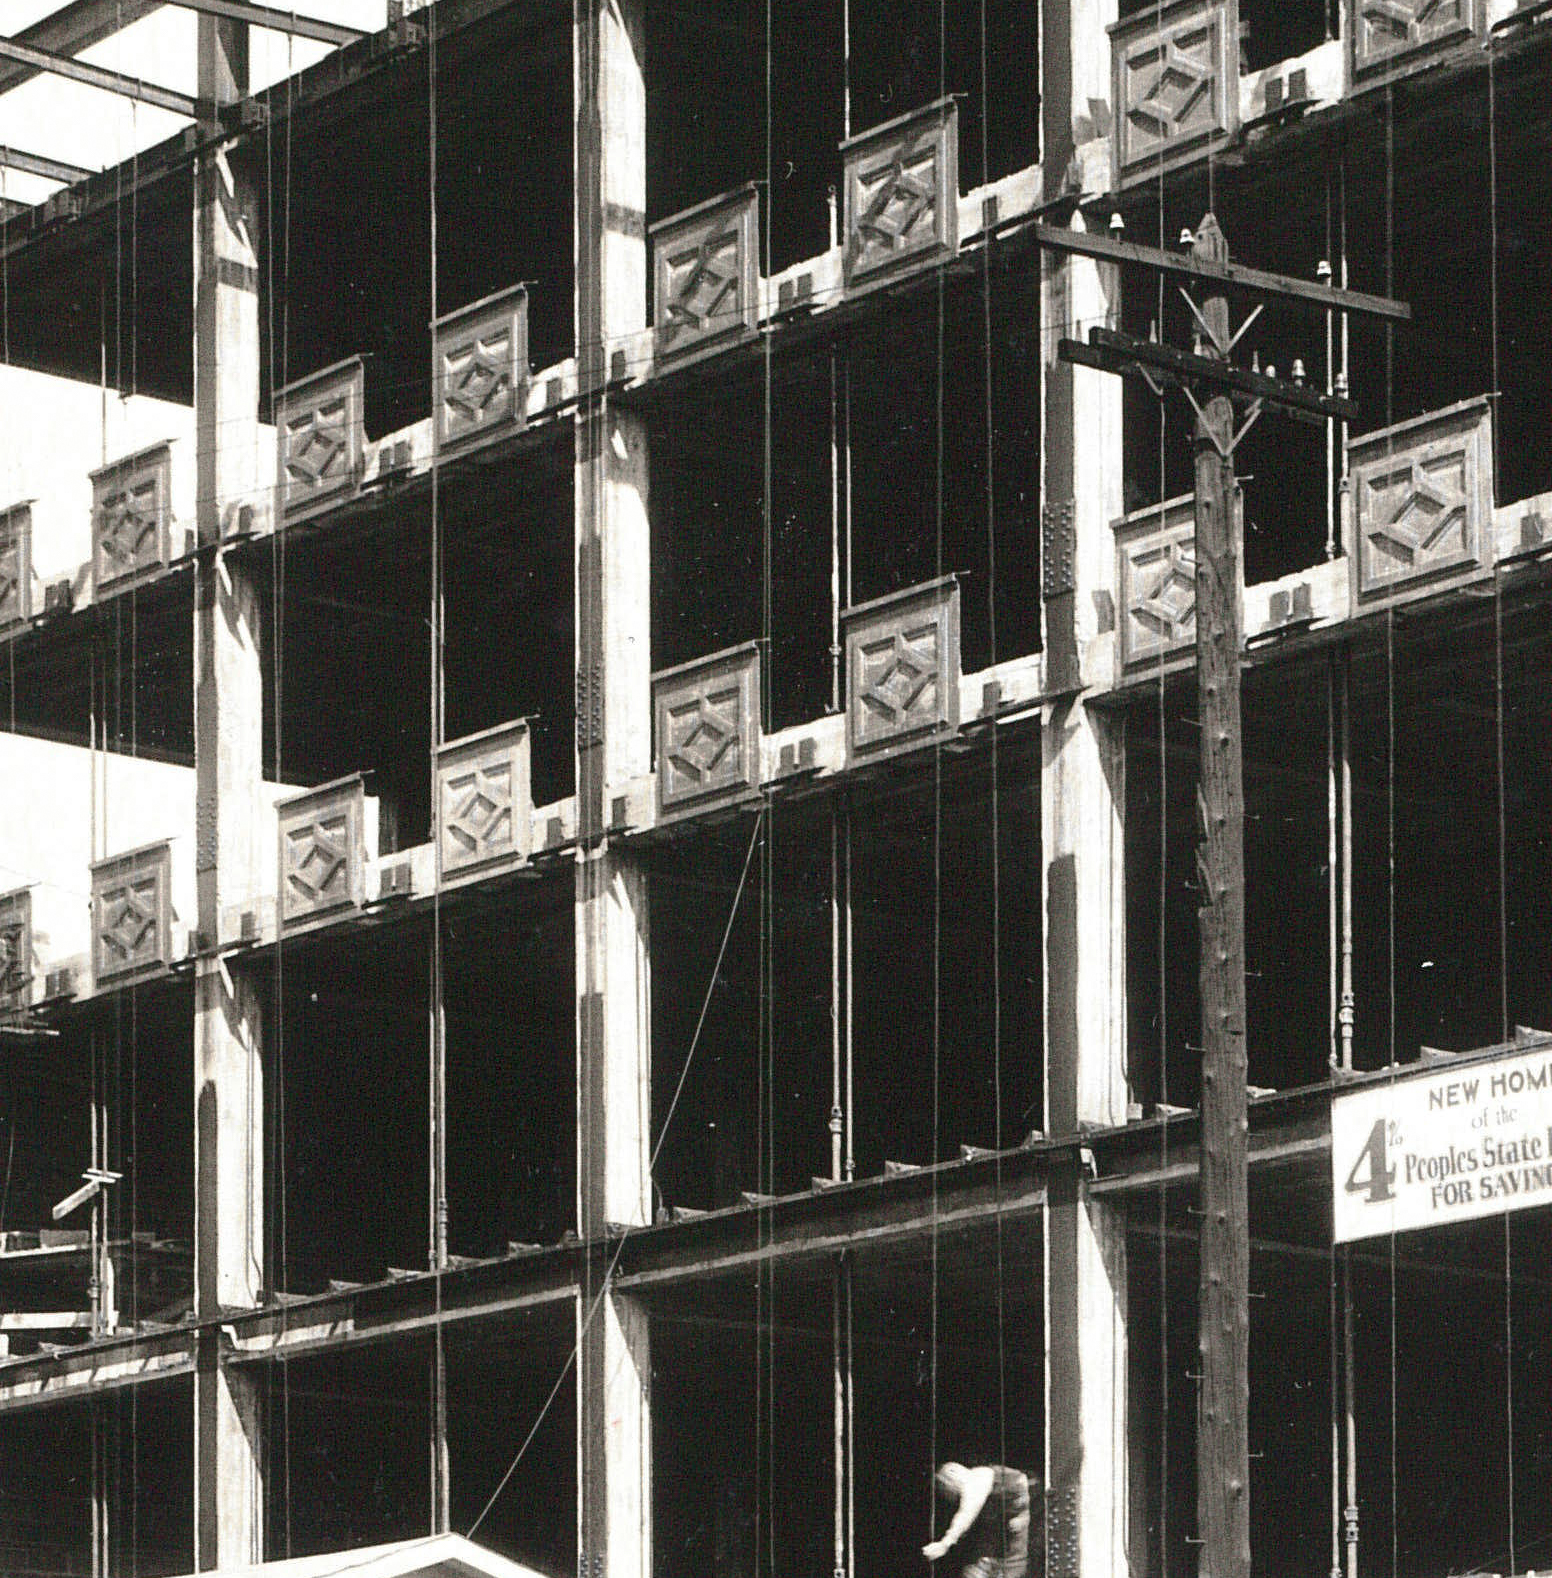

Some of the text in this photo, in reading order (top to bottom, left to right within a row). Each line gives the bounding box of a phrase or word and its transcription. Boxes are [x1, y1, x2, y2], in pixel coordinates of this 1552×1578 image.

[1429, 1079, 1481, 1112] NEW
[1471, 1105, 1517, 1130] of the
[1406, 1144, 1479, 1184] Peoples
[1482, 1135, 1542, 1168] State
[1431, 1178, 1473, 1209] FOR
